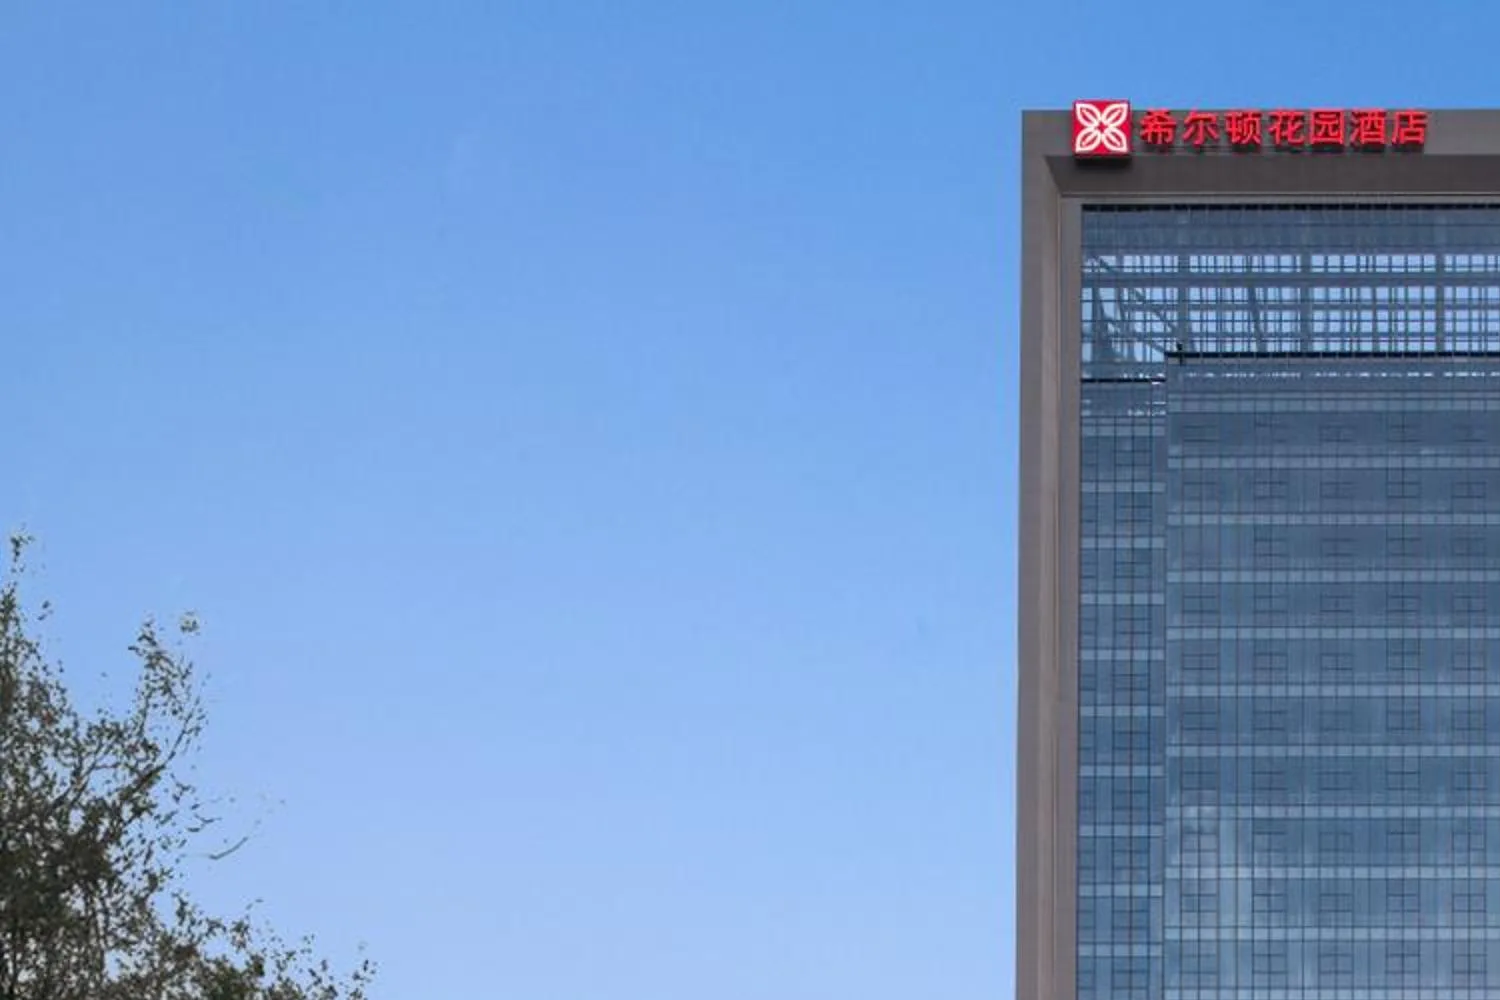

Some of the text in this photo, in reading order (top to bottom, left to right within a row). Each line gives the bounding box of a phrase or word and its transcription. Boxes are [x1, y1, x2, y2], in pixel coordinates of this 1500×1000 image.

[1139, 109, 1429, 146] 希尔顿花园酒店
